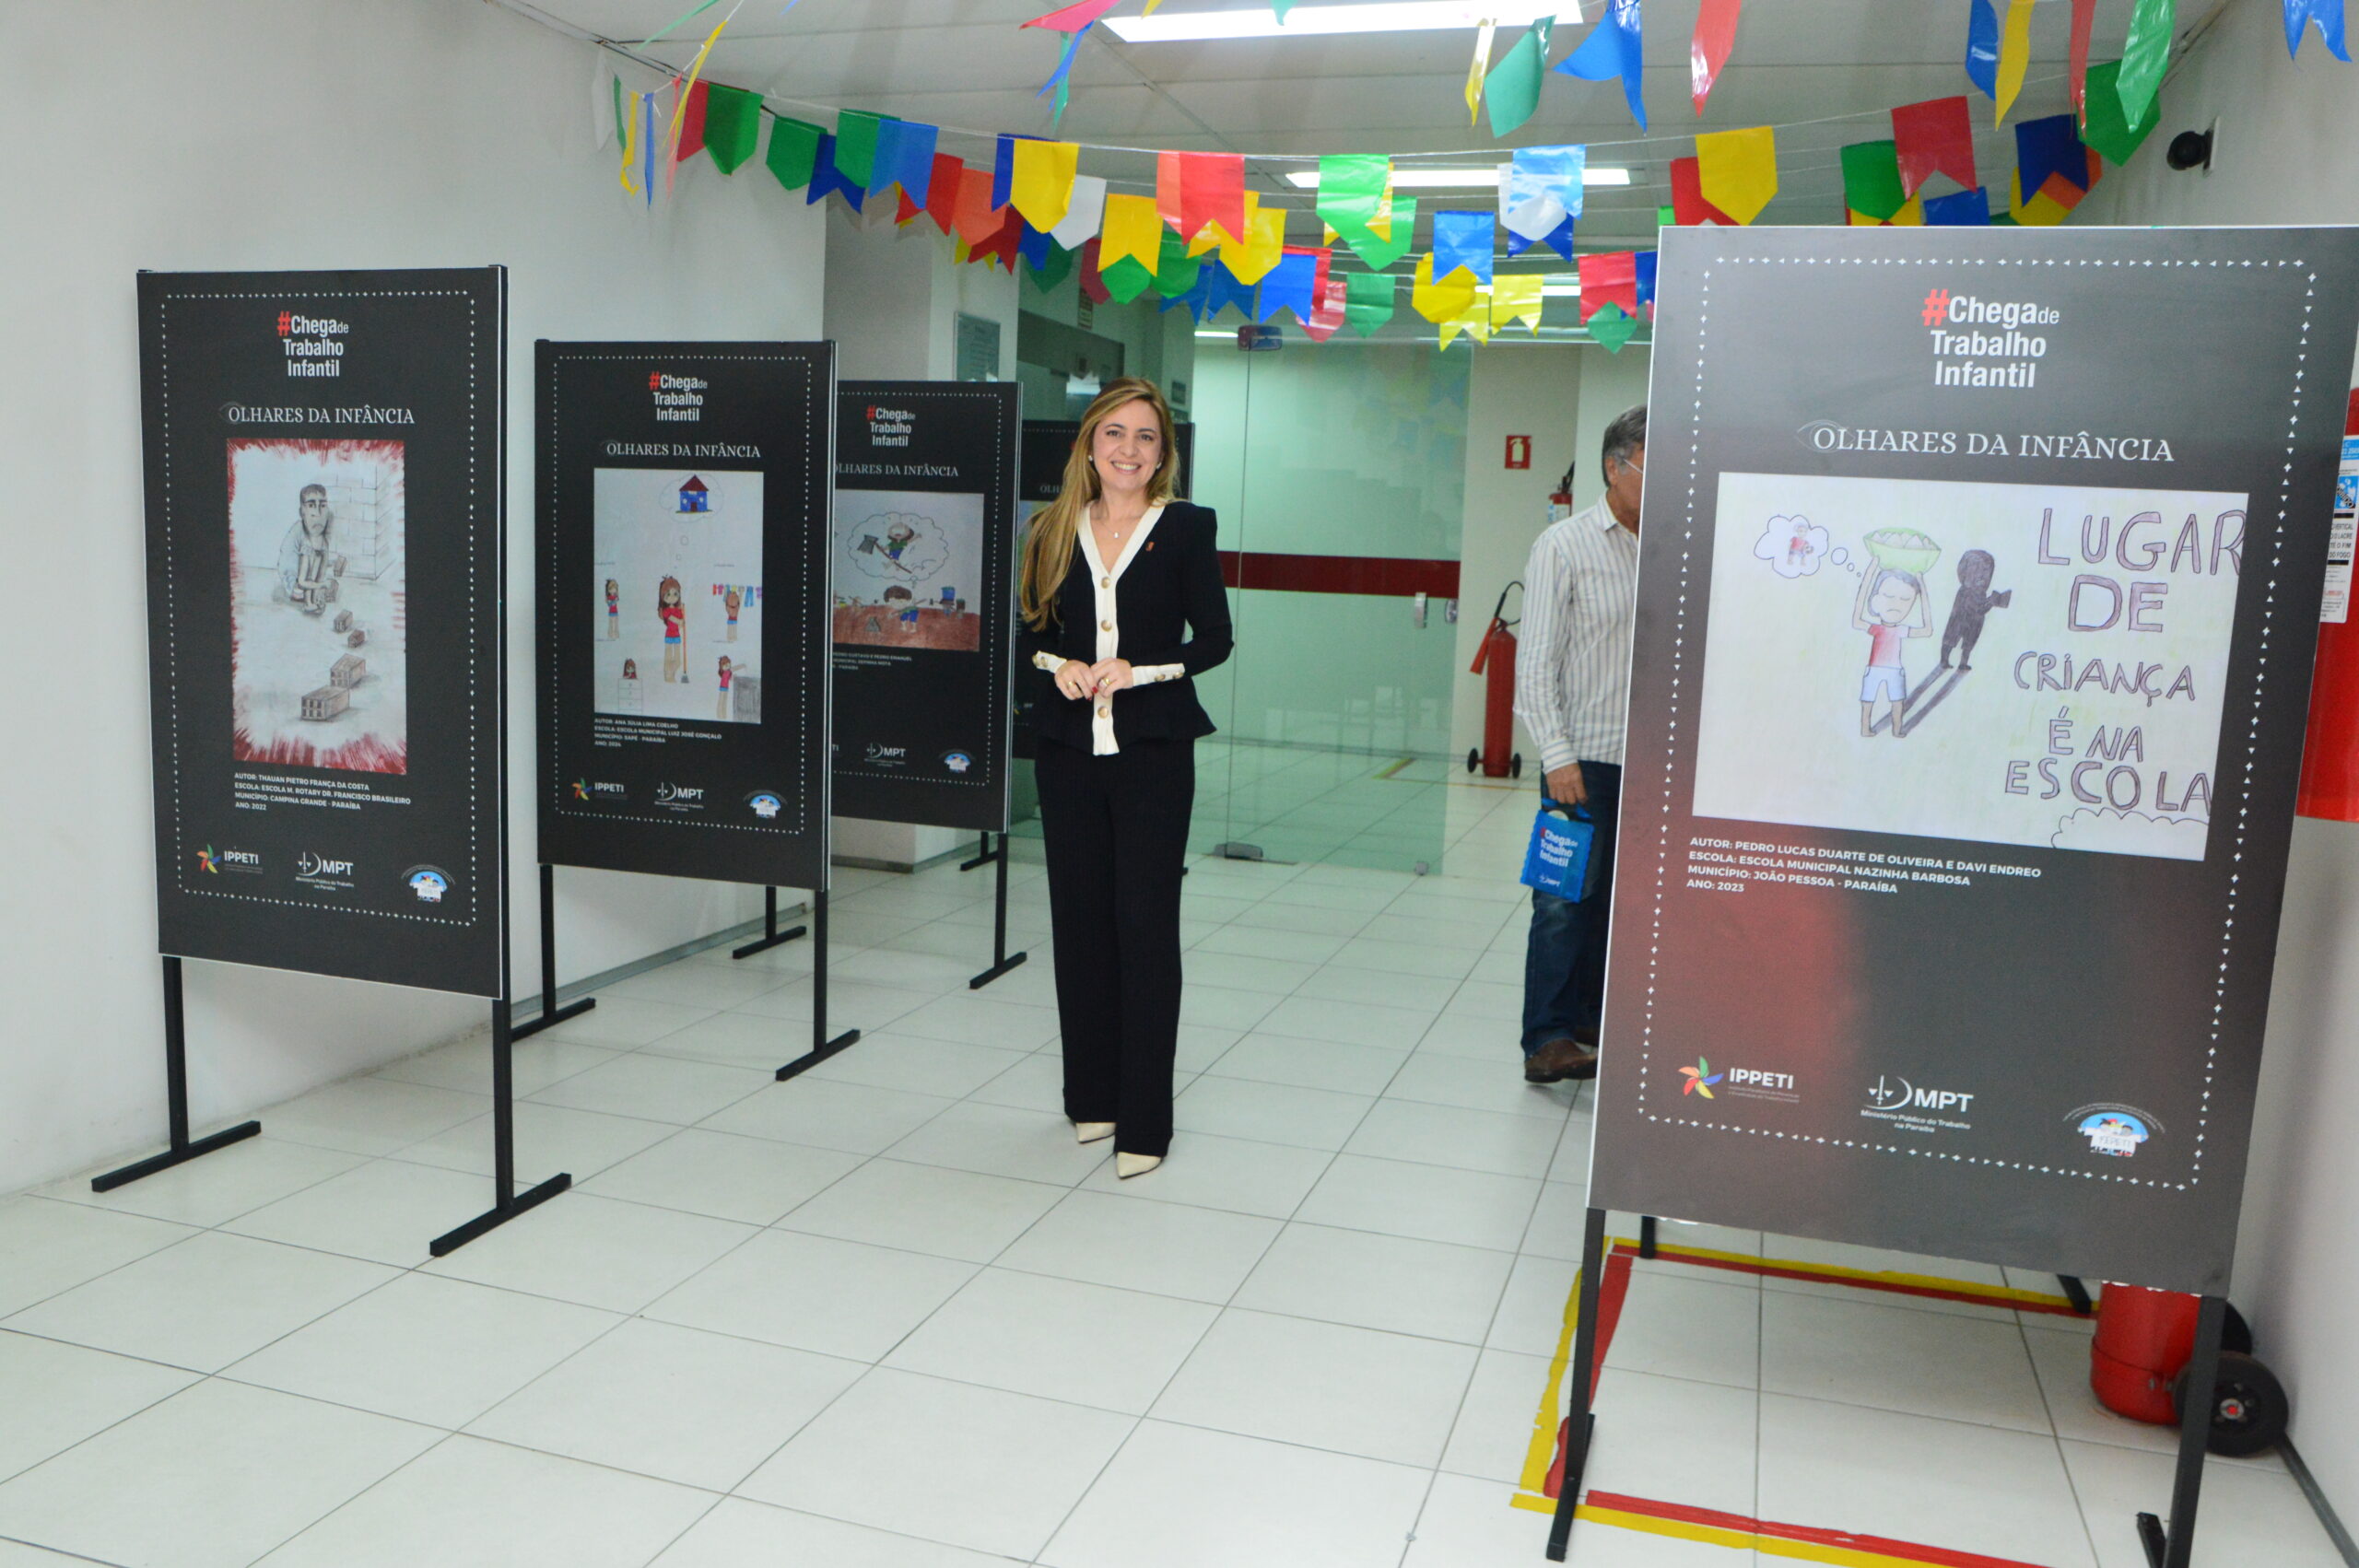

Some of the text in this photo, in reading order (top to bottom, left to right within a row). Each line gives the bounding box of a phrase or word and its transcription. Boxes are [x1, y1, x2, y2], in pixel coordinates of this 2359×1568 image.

[283, 339, 344, 356] Trabalho
[1931, 330, 2047, 357] Trabalho
[288, 359, 339, 376] Infantil
[1935, 361, 2036, 388] Infantil
[653, 392, 703, 405] Trabalho
[229, 405, 415, 424] OLHARES DA INFÂNCIA
[656, 408, 699, 421] Infantil
[870, 422, 911, 434] Trabalho
[606, 442, 760, 457] OLHARES DA INFÂNCIA
[872, 435, 909, 447] Infantil
[1813, 427, 2175, 462] OLHARES DA INFÂNCIA
[886, 464, 900, 474] DA
[904, 463, 958, 476] INFÂNCIA
[2038, 509, 2247, 576] LUGAR
[2068, 574, 2168, 633] DE
[2048, 706, 2143, 762] É NA
[884, 747, 906, 757] MPT
[259, 774, 285, 783] THAUAN
[286, 777, 309, 786] PIETRO
[310, 778, 336, 789] FRANÇA
[337, 780, 346, 789] DA
[347, 782, 370, 790] COSTA
[594, 782, 624, 793] IPPETI
[2005, 757, 2212, 816] ESCOLA
[262, 785, 286, 793] ESCOLA
[295, 788, 321, 797] ROTARY
[334, 790, 371, 802] FRANCISCO
[371, 794, 411, 805] BRASILEIRO
[270, 794, 299, 804] CAMPINA
[300, 798, 327, 807] GRANDE
[332, 800, 361, 810] PARAÍBA
[677, 788, 704, 800] MPT
[224, 850, 259, 865] IPPETI
[1689, 837, 2041, 879] AUTOR: PEDRO LUCAS DUARTE DE OLIVEIRA E DAVI ENDREO
[323, 860, 354, 876] MPT
[1688, 851, 1970, 886] ESCOLA: ESCOLA MUNICIPAL NAZINHA BARBOSA
[1686, 879, 1744, 893] ANO: 2023
[1687, 863, 1752, 880] MUNICÍPIO:
[1753, 868, 1786, 883] JOÃO
[1788, 873, 1835, 888] PESSOA
[1844, 877, 1897, 894] PARAÍBA
[1729, 1067, 1794, 1089] IPPETI
[1914, 1087, 1974, 1112] MPT
[1938, 1118, 1971, 1129] Trabalho
